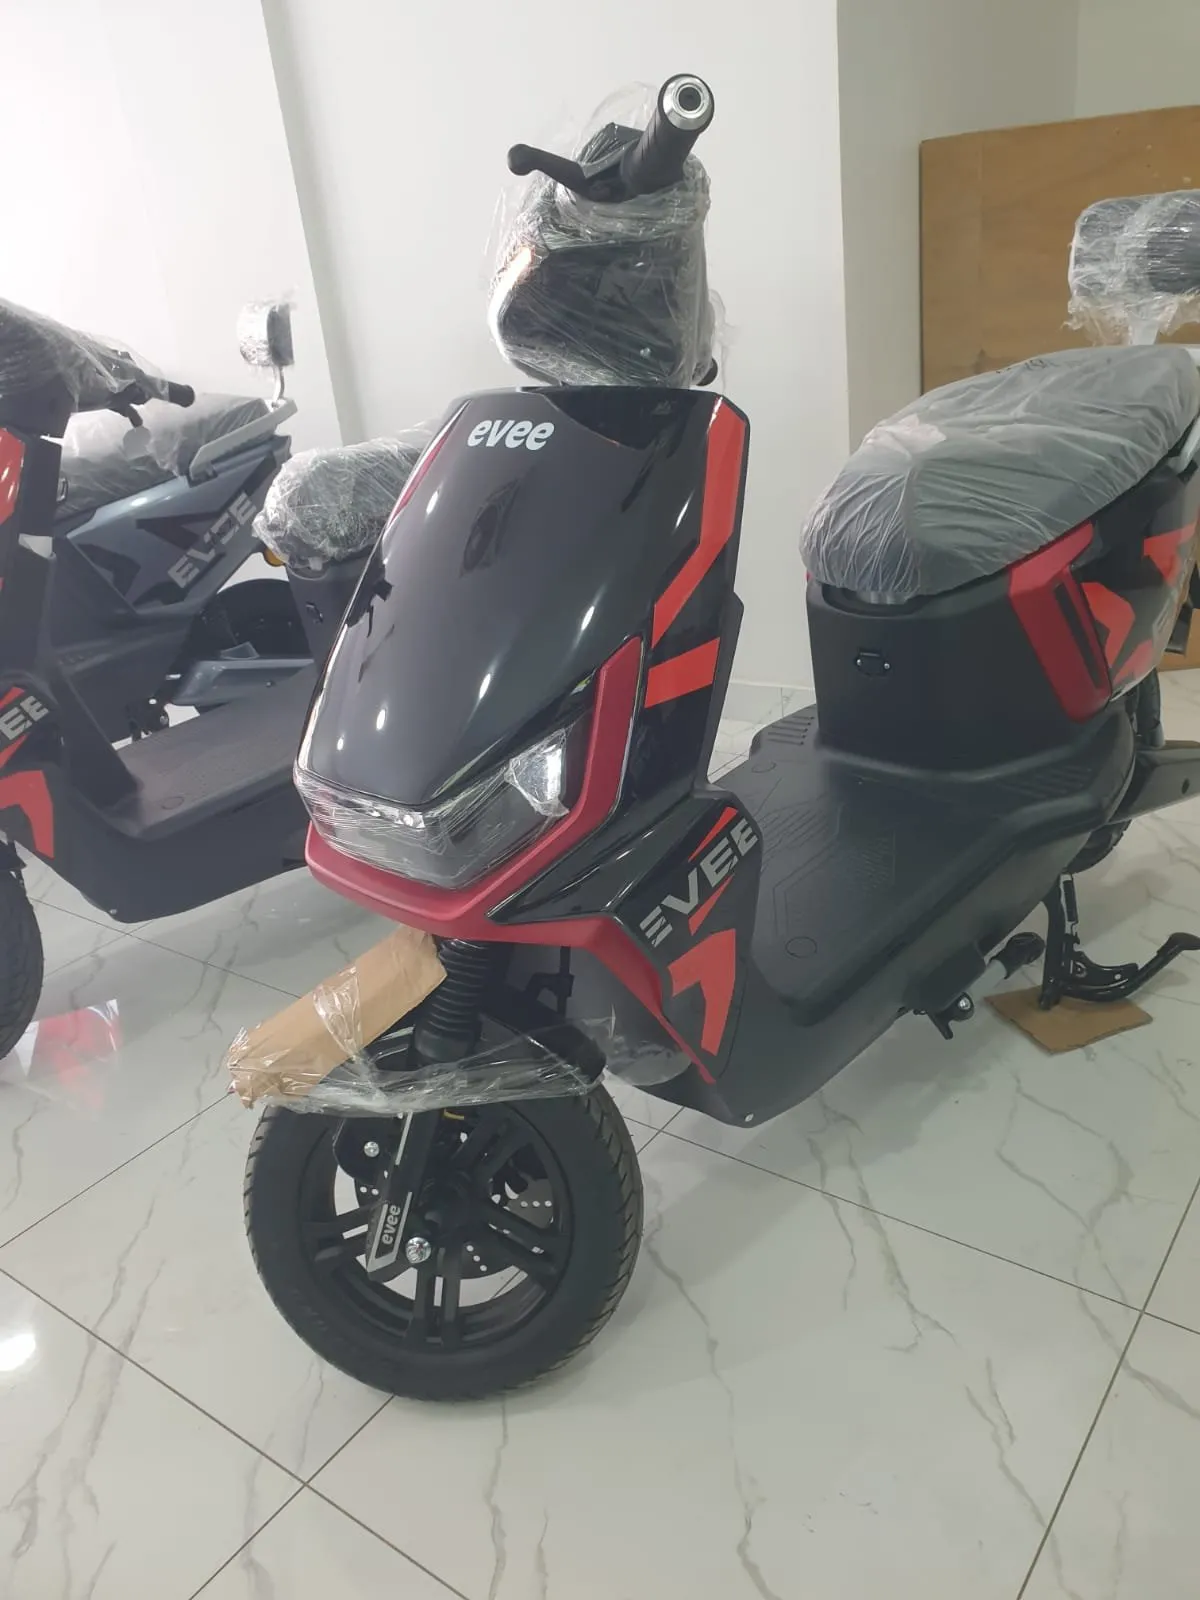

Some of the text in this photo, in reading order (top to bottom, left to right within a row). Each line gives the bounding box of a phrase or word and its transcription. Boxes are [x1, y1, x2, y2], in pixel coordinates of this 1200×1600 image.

[467, 420, 555, 450] evee
[639, 818, 759, 947] EVEE
[382, 1205, 401, 1245] evee
